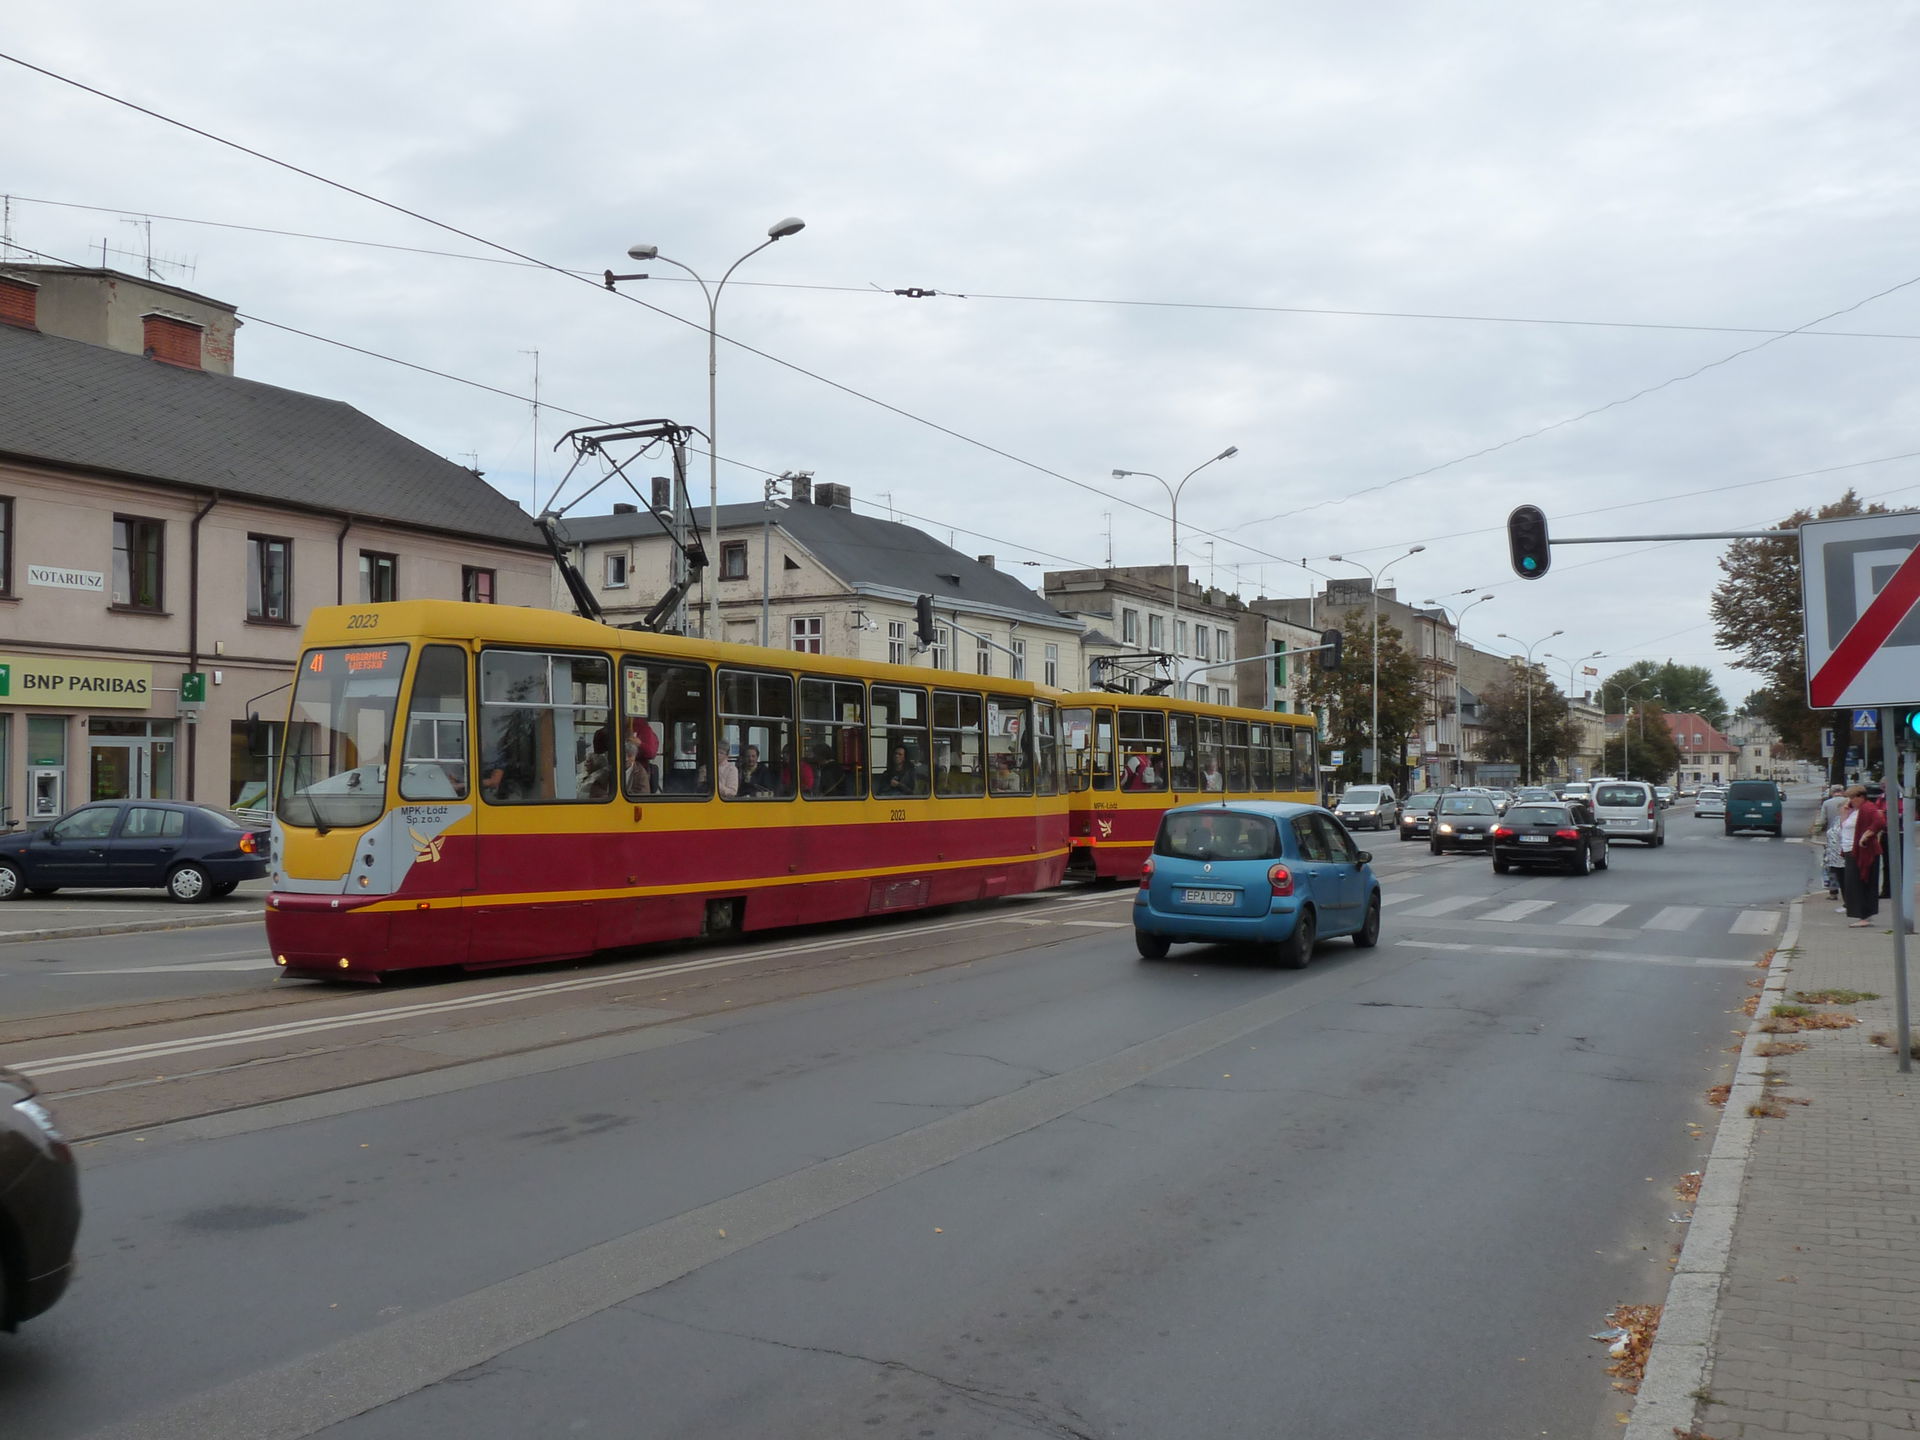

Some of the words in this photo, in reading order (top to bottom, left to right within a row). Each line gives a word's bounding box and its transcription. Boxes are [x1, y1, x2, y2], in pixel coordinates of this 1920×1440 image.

[31, 569, 102, 588] NOTARIUSZ
[347, 614, 379, 629] 2023
[310, 653, 324, 672] 41
[23, 674, 64, 690] BNP
[68, 676, 147, 694] PARIBAS
[890, 809, 906, 821] 2023
[1187, 890, 1206, 901] EPA
[1209, 892, 1232, 903] UC29
